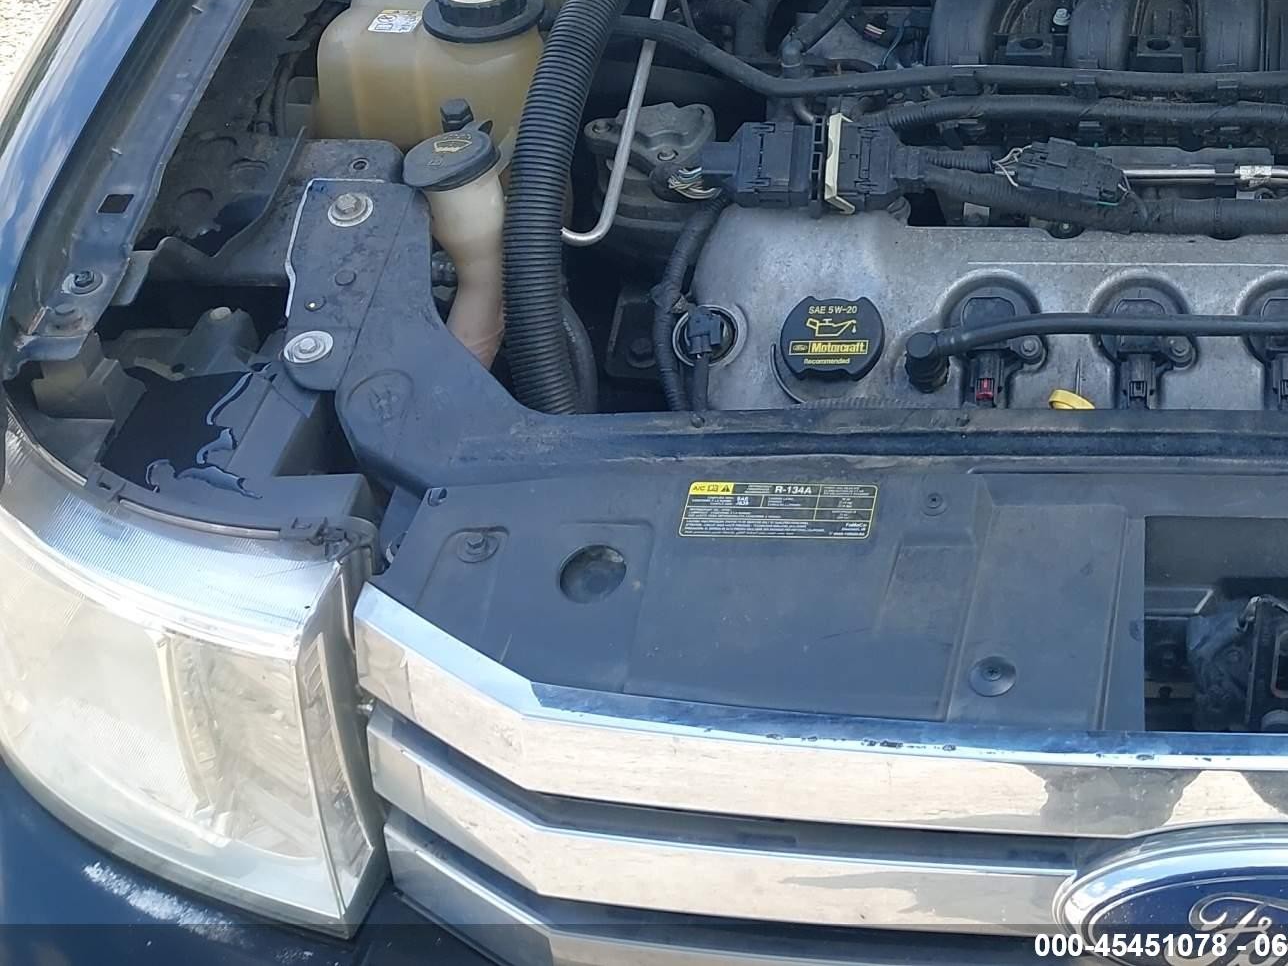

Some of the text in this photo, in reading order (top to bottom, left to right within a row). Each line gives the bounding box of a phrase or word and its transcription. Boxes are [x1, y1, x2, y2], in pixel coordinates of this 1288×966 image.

[808, 305, 858, 314] SAE 5W-20
[811, 342, 865, 353] Motorcraft
[803, 357, 851, 365] Recommended
[774, 485, 813, 494] R-134A
